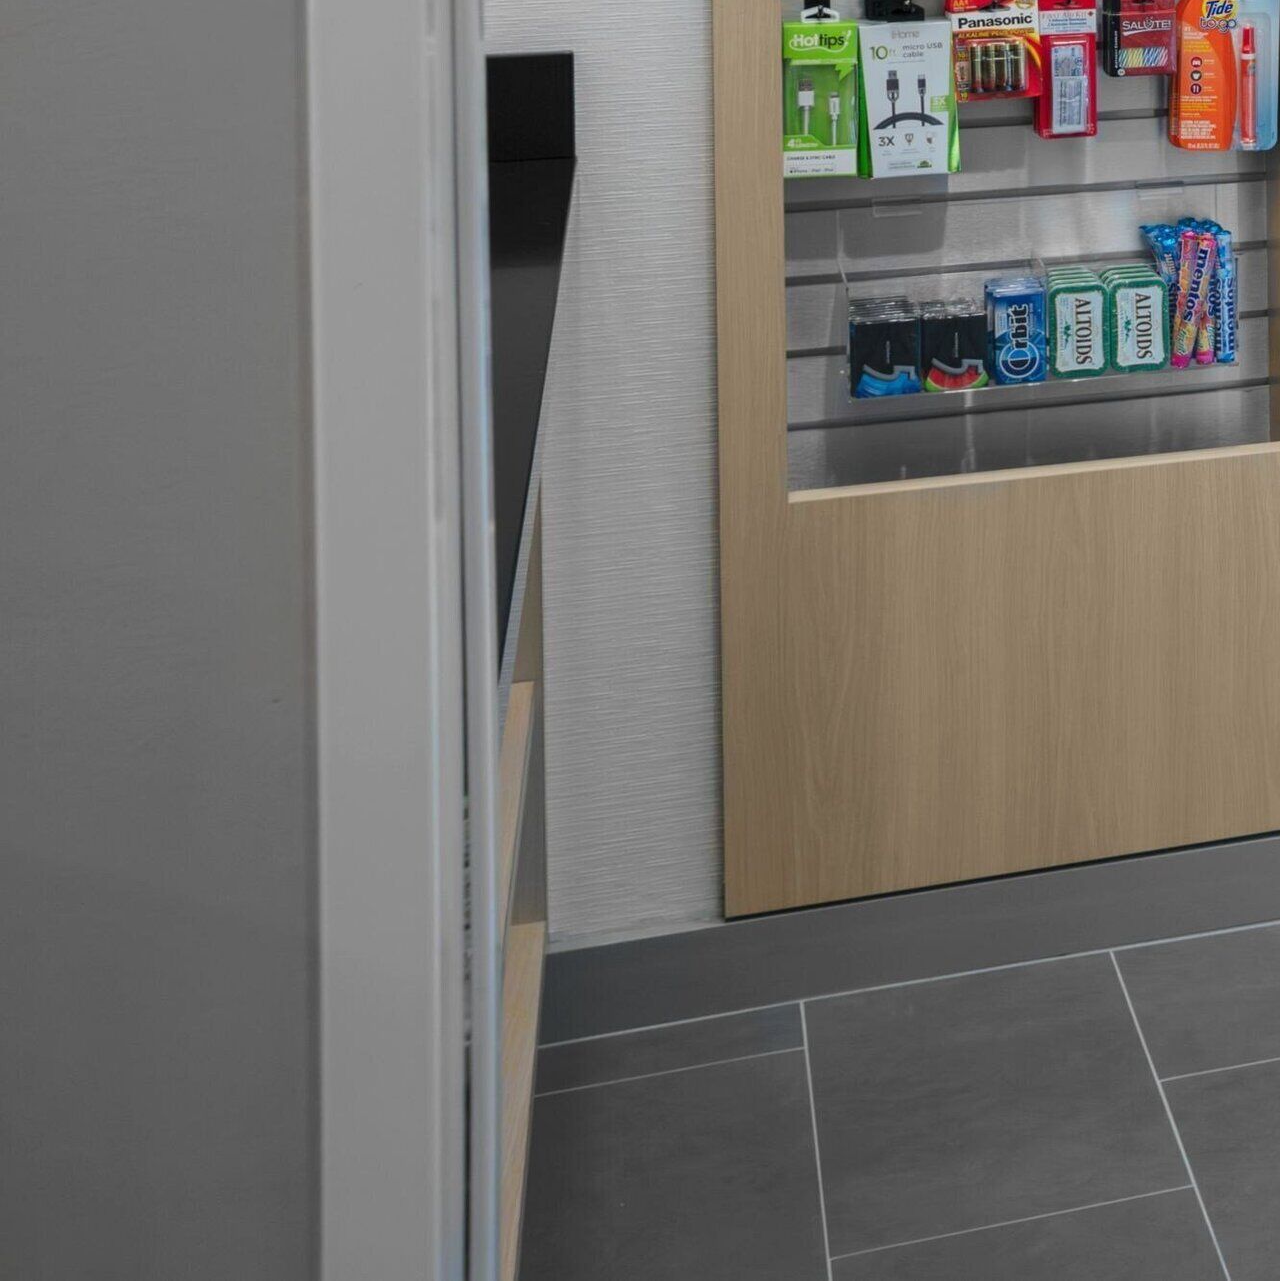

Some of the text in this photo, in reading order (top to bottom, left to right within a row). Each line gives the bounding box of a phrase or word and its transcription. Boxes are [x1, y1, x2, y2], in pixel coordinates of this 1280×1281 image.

[1206, 0, 1234, 19] Tide
[958, 12, 1032, 29] Panasonic
[871, 45, 888, 61] 10
[902, 42, 943, 51] micro USB
[902, 50, 924, 58] cable
[878, 136, 895, 147] 3X
[1183, 247, 1210, 323] mentos
[1074, 297, 1093, 366] ALTOIDS
[1134, 292, 1153, 359] ALTOIDS
